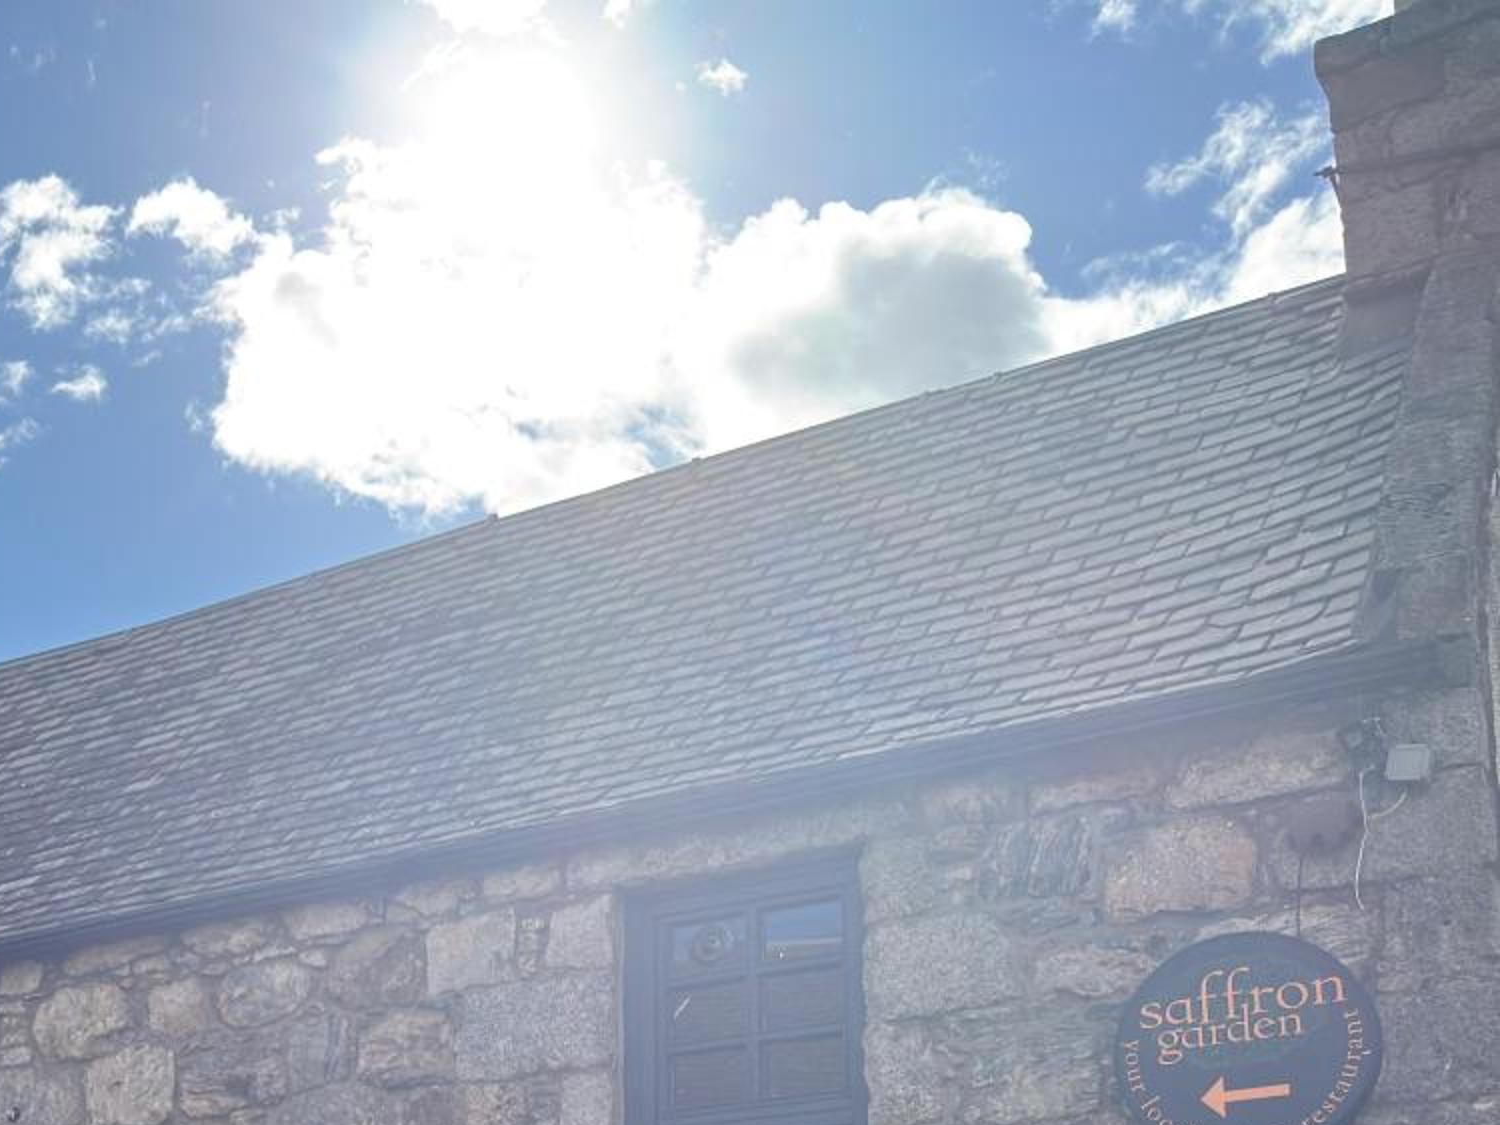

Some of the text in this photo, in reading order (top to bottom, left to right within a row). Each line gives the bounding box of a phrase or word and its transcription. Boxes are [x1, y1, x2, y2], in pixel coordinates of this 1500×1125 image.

[1139, 967, 1348, 1029] saffron
[1157, 1003, 1304, 1066] garden
[1123, 1039, 1147, 1093] your
